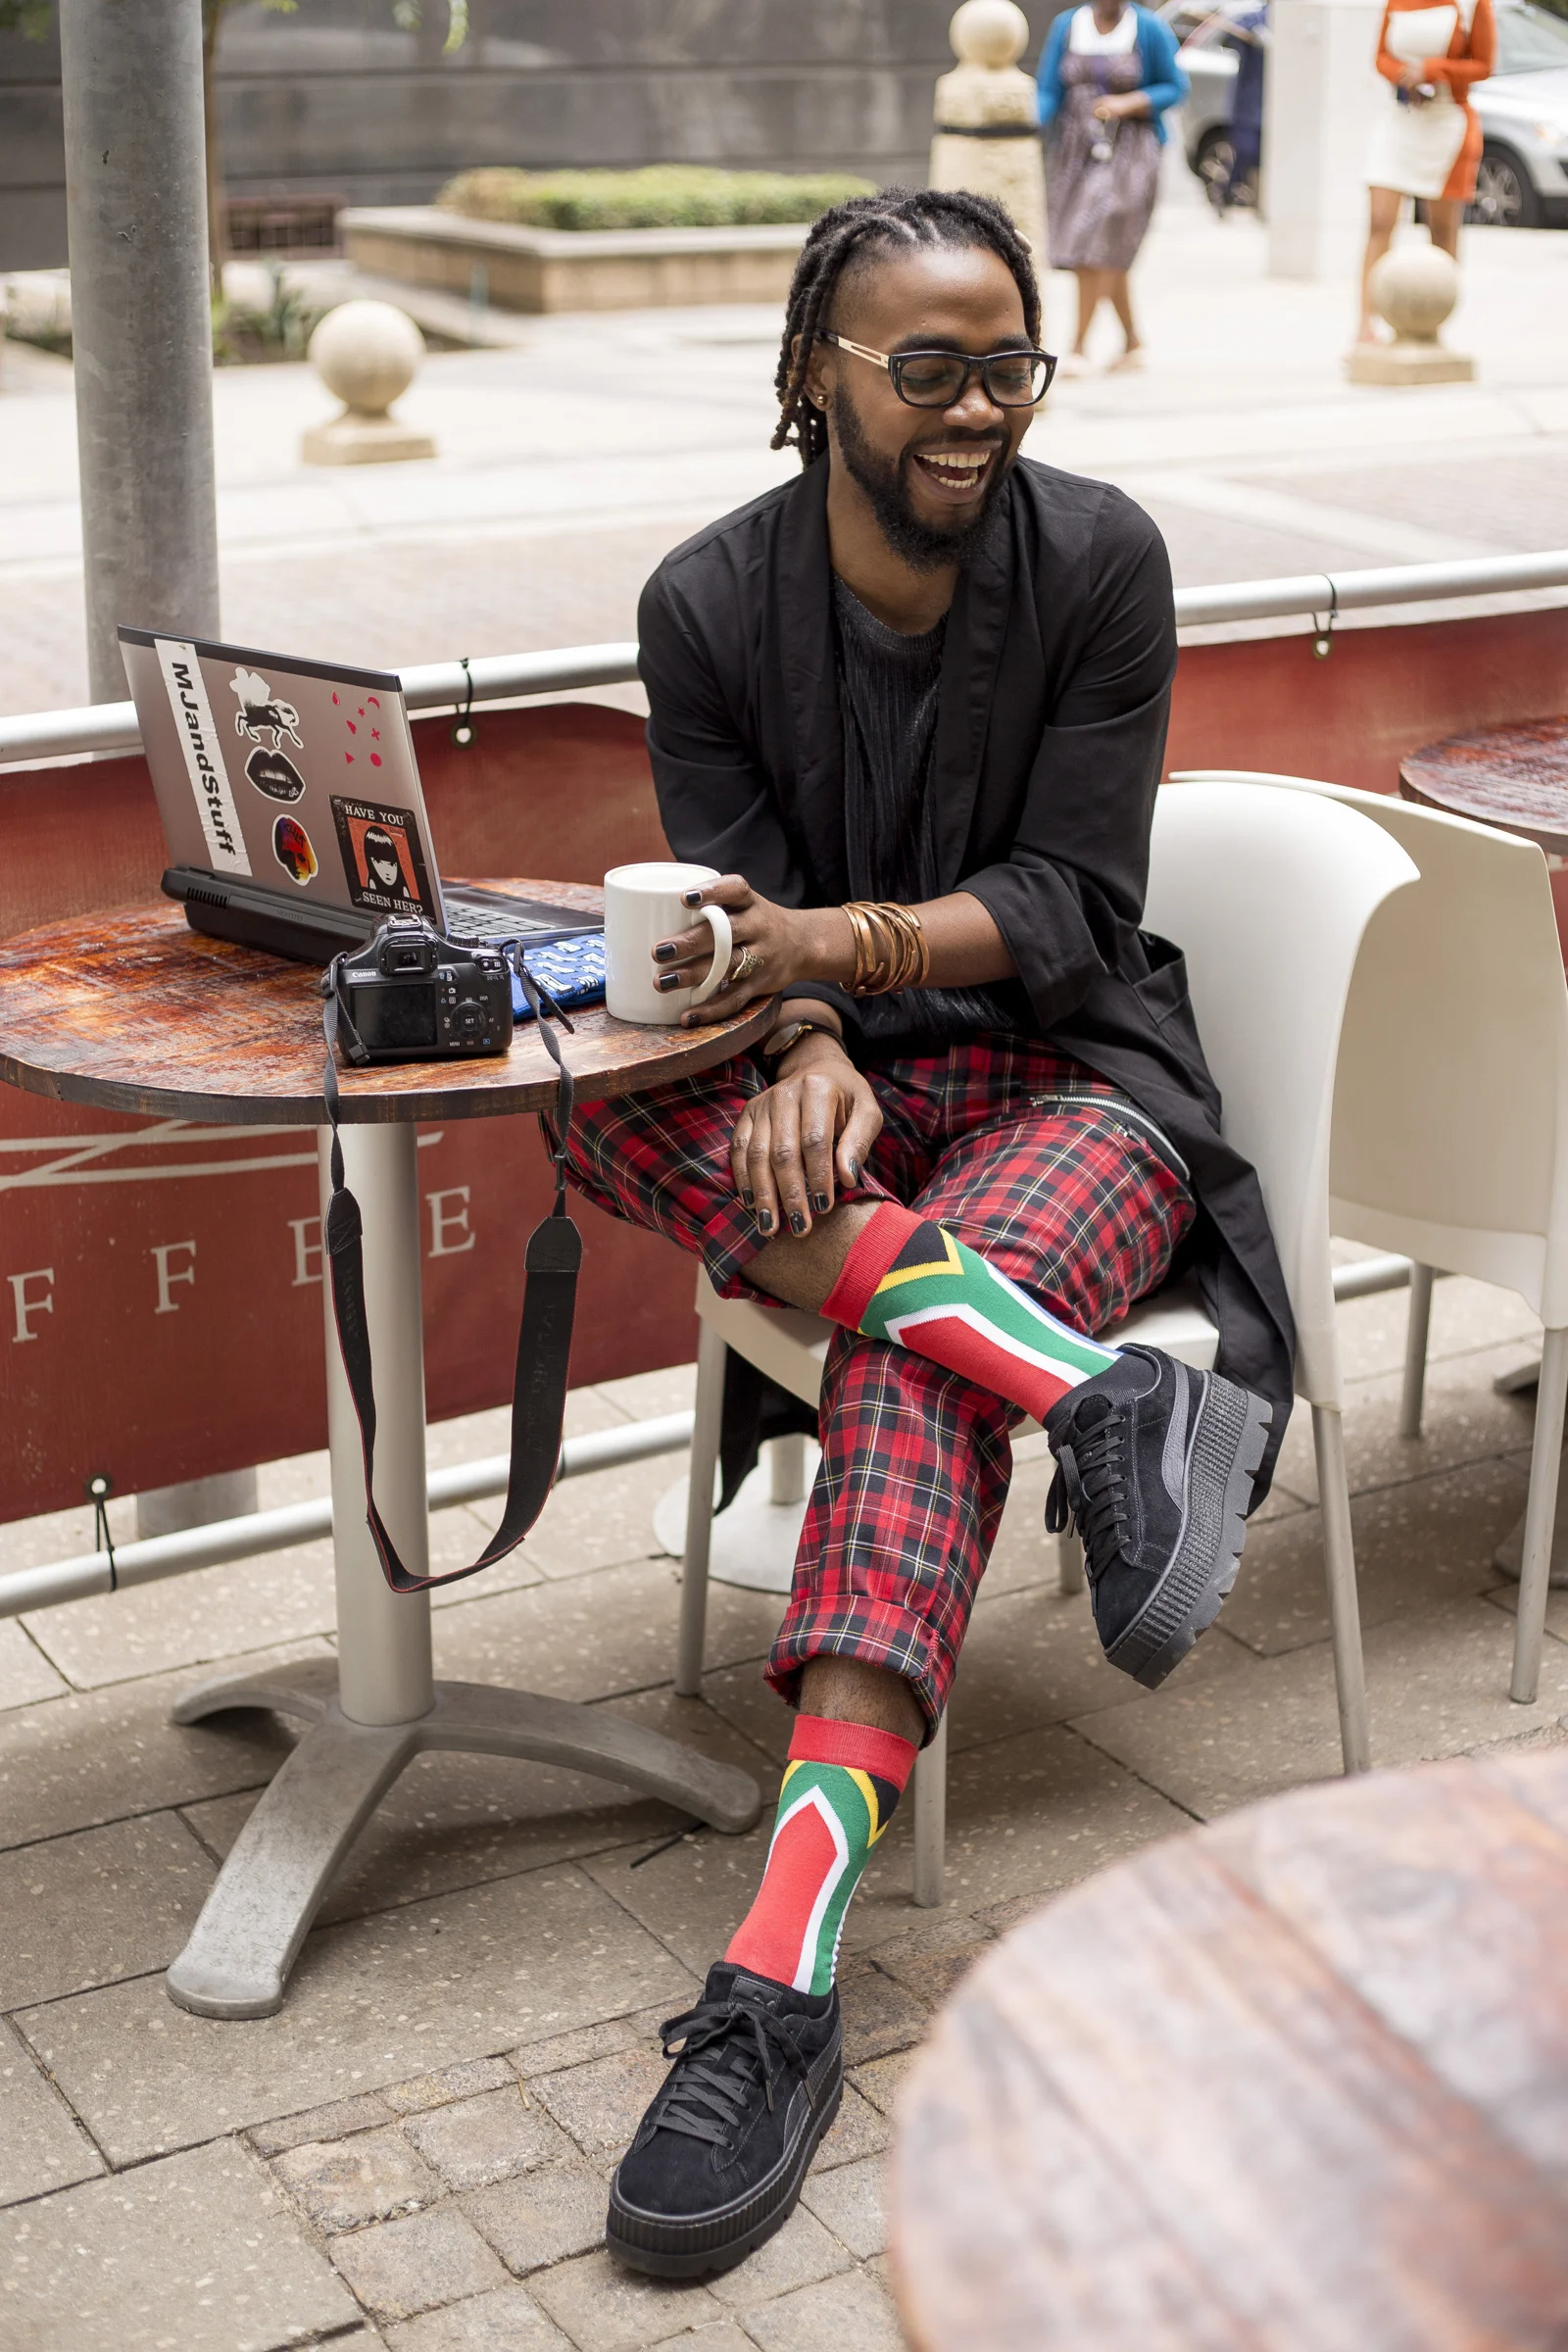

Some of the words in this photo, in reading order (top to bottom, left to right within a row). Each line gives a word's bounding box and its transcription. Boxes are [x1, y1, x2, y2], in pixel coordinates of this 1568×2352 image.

[172, 662, 236, 856] MJandStuff
[345, 805, 375, 820] HAVE
[379, 811, 404, 826] YOU
[362, 891, 392, 907] SEEN
[393, 899, 423, 914] HER?
